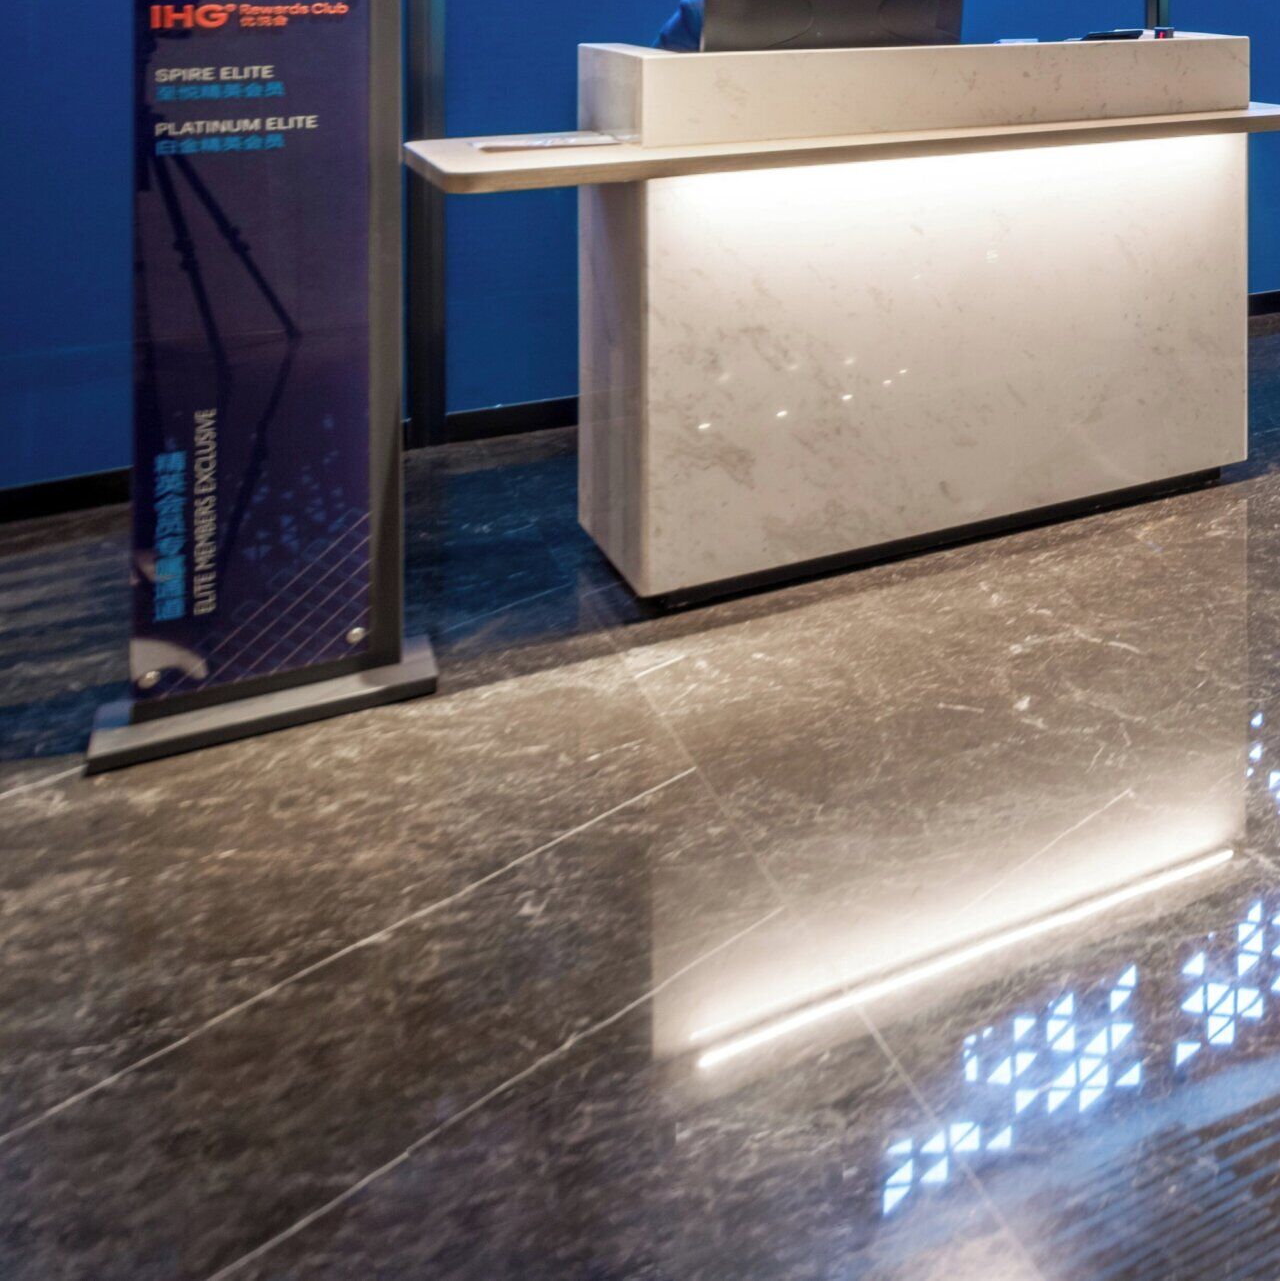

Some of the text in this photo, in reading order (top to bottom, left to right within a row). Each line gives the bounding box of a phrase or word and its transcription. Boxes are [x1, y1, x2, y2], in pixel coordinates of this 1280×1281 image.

[239, 3, 309, 15] Rewards
[311, 2, 350, 15] Club
[154, 65, 275, 82] SPIRE ELITE
[154, 115, 320, 137] PLATINUM ELITE
[193, 408, 217, 616] ELITE MEMBERS EXCLUSIVE
